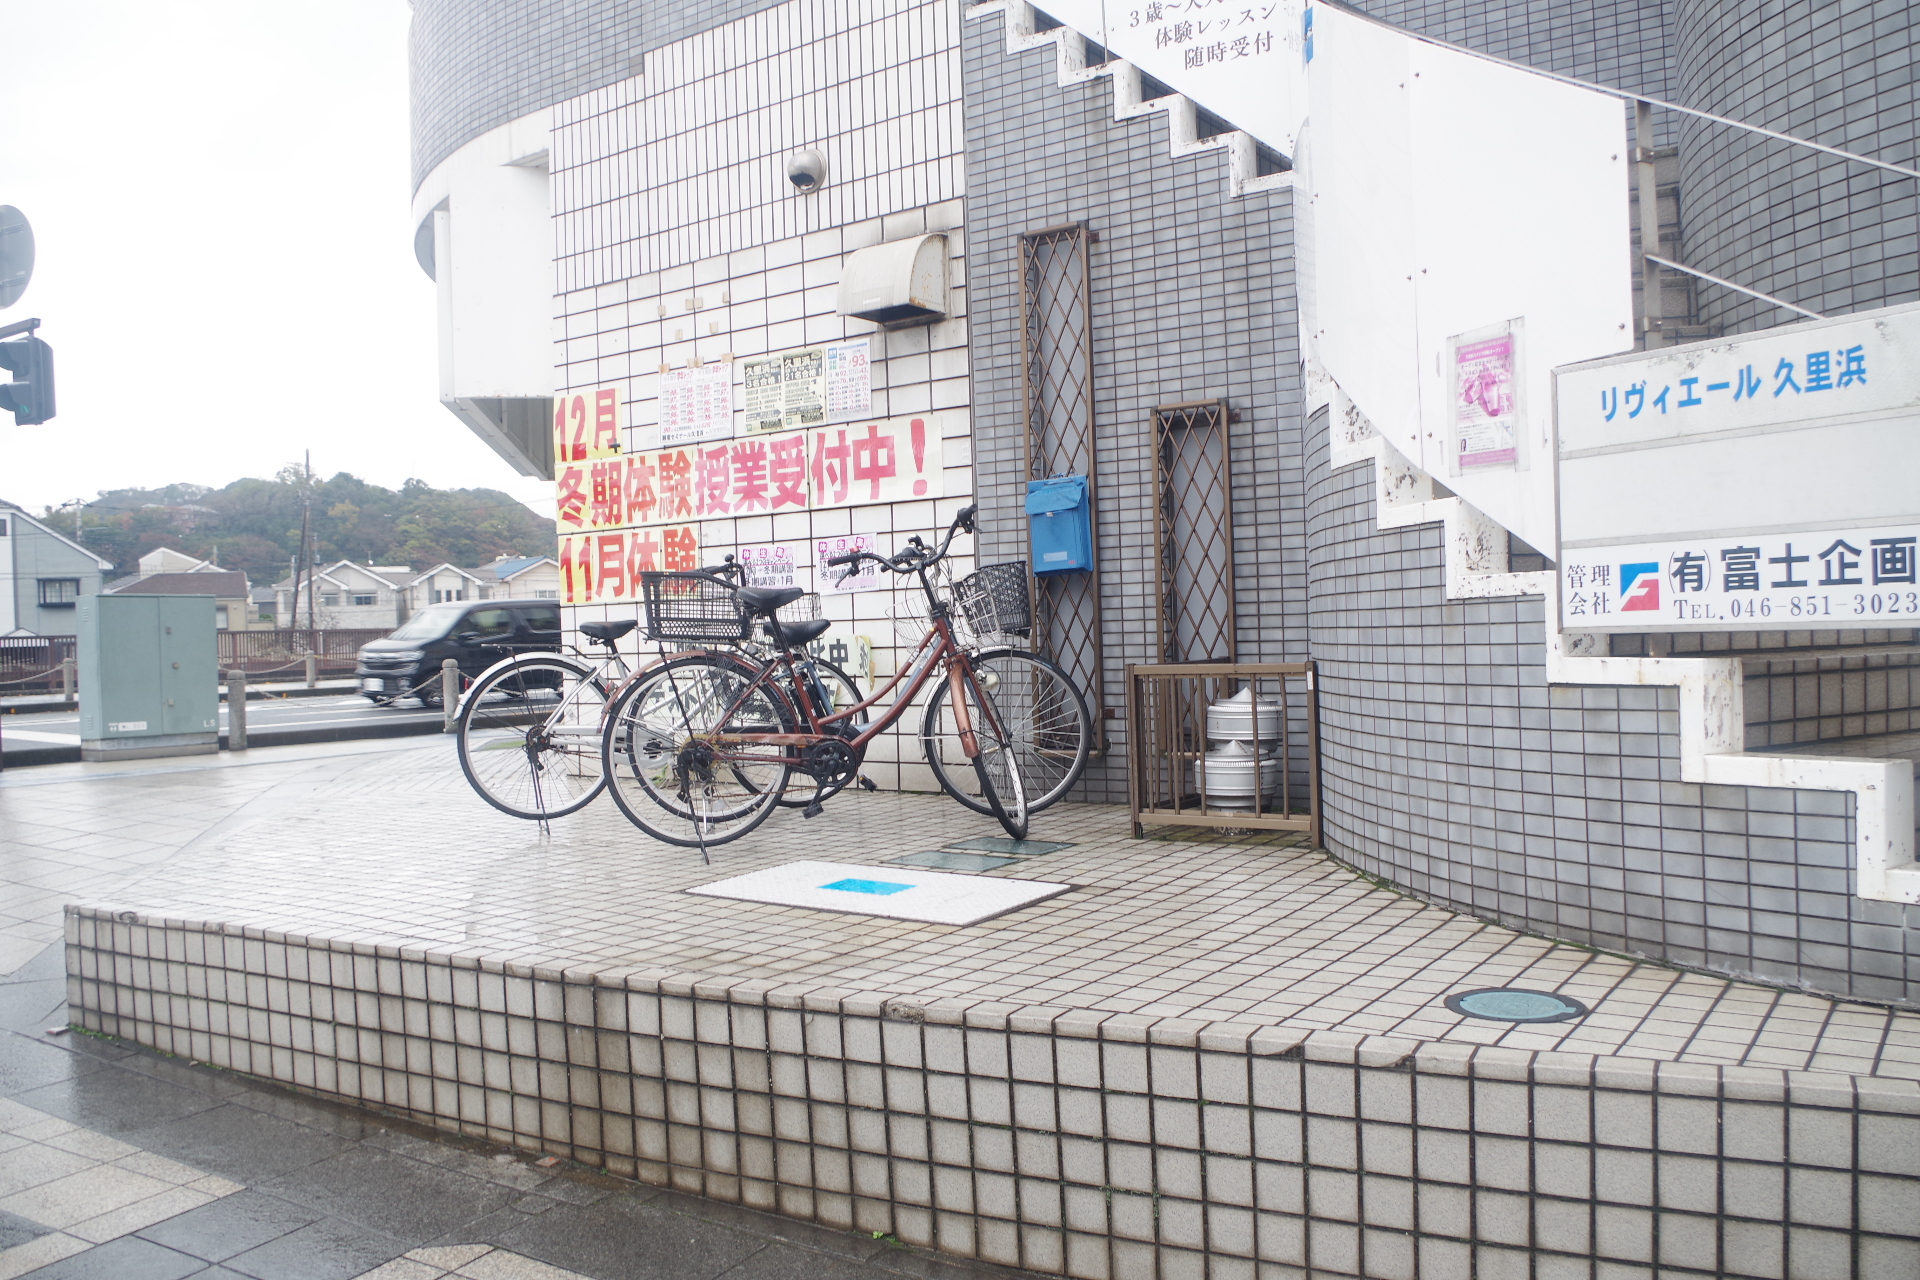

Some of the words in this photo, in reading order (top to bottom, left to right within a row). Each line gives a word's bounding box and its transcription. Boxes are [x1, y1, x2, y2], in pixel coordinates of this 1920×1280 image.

[1155, 3, 1277, 49] 体験レッスン
[1184, 31, 1274, 70] 随時受付
[556, 418, 928, 528] 冬期体験授業受付中！
[1567, 564, 1611, 589] 管理
[1568, 591, 1612, 616] 会社
